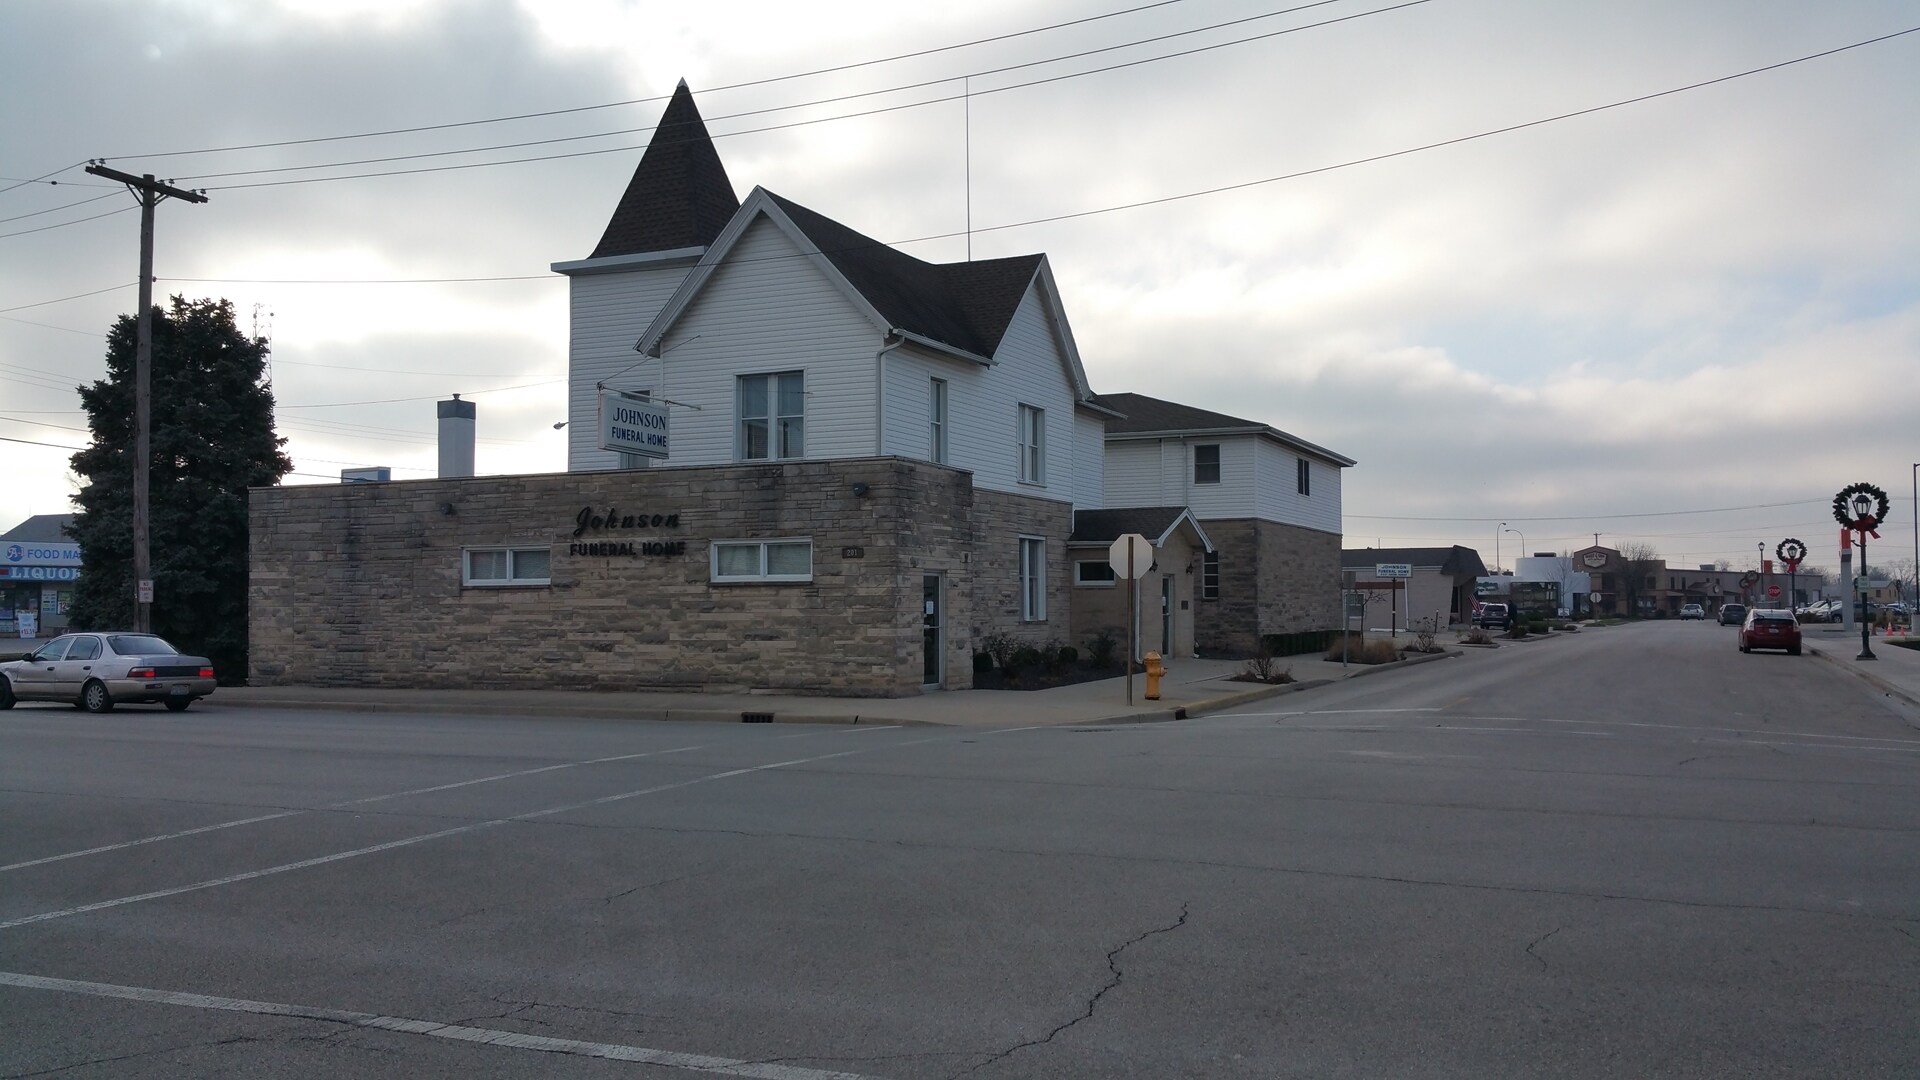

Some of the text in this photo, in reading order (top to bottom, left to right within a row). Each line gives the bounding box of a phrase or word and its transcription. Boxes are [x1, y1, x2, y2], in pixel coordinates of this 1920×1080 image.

[613, 407, 667, 431] JOHNSON
[611, 426, 667, 448] FUNERAL HOME
[573, 506, 680, 536] Johnson
[27, 549, 60, 559] FOOD
[63, 550, 80, 560] MA
[570, 541, 686, 556] FUNERAL HOME
